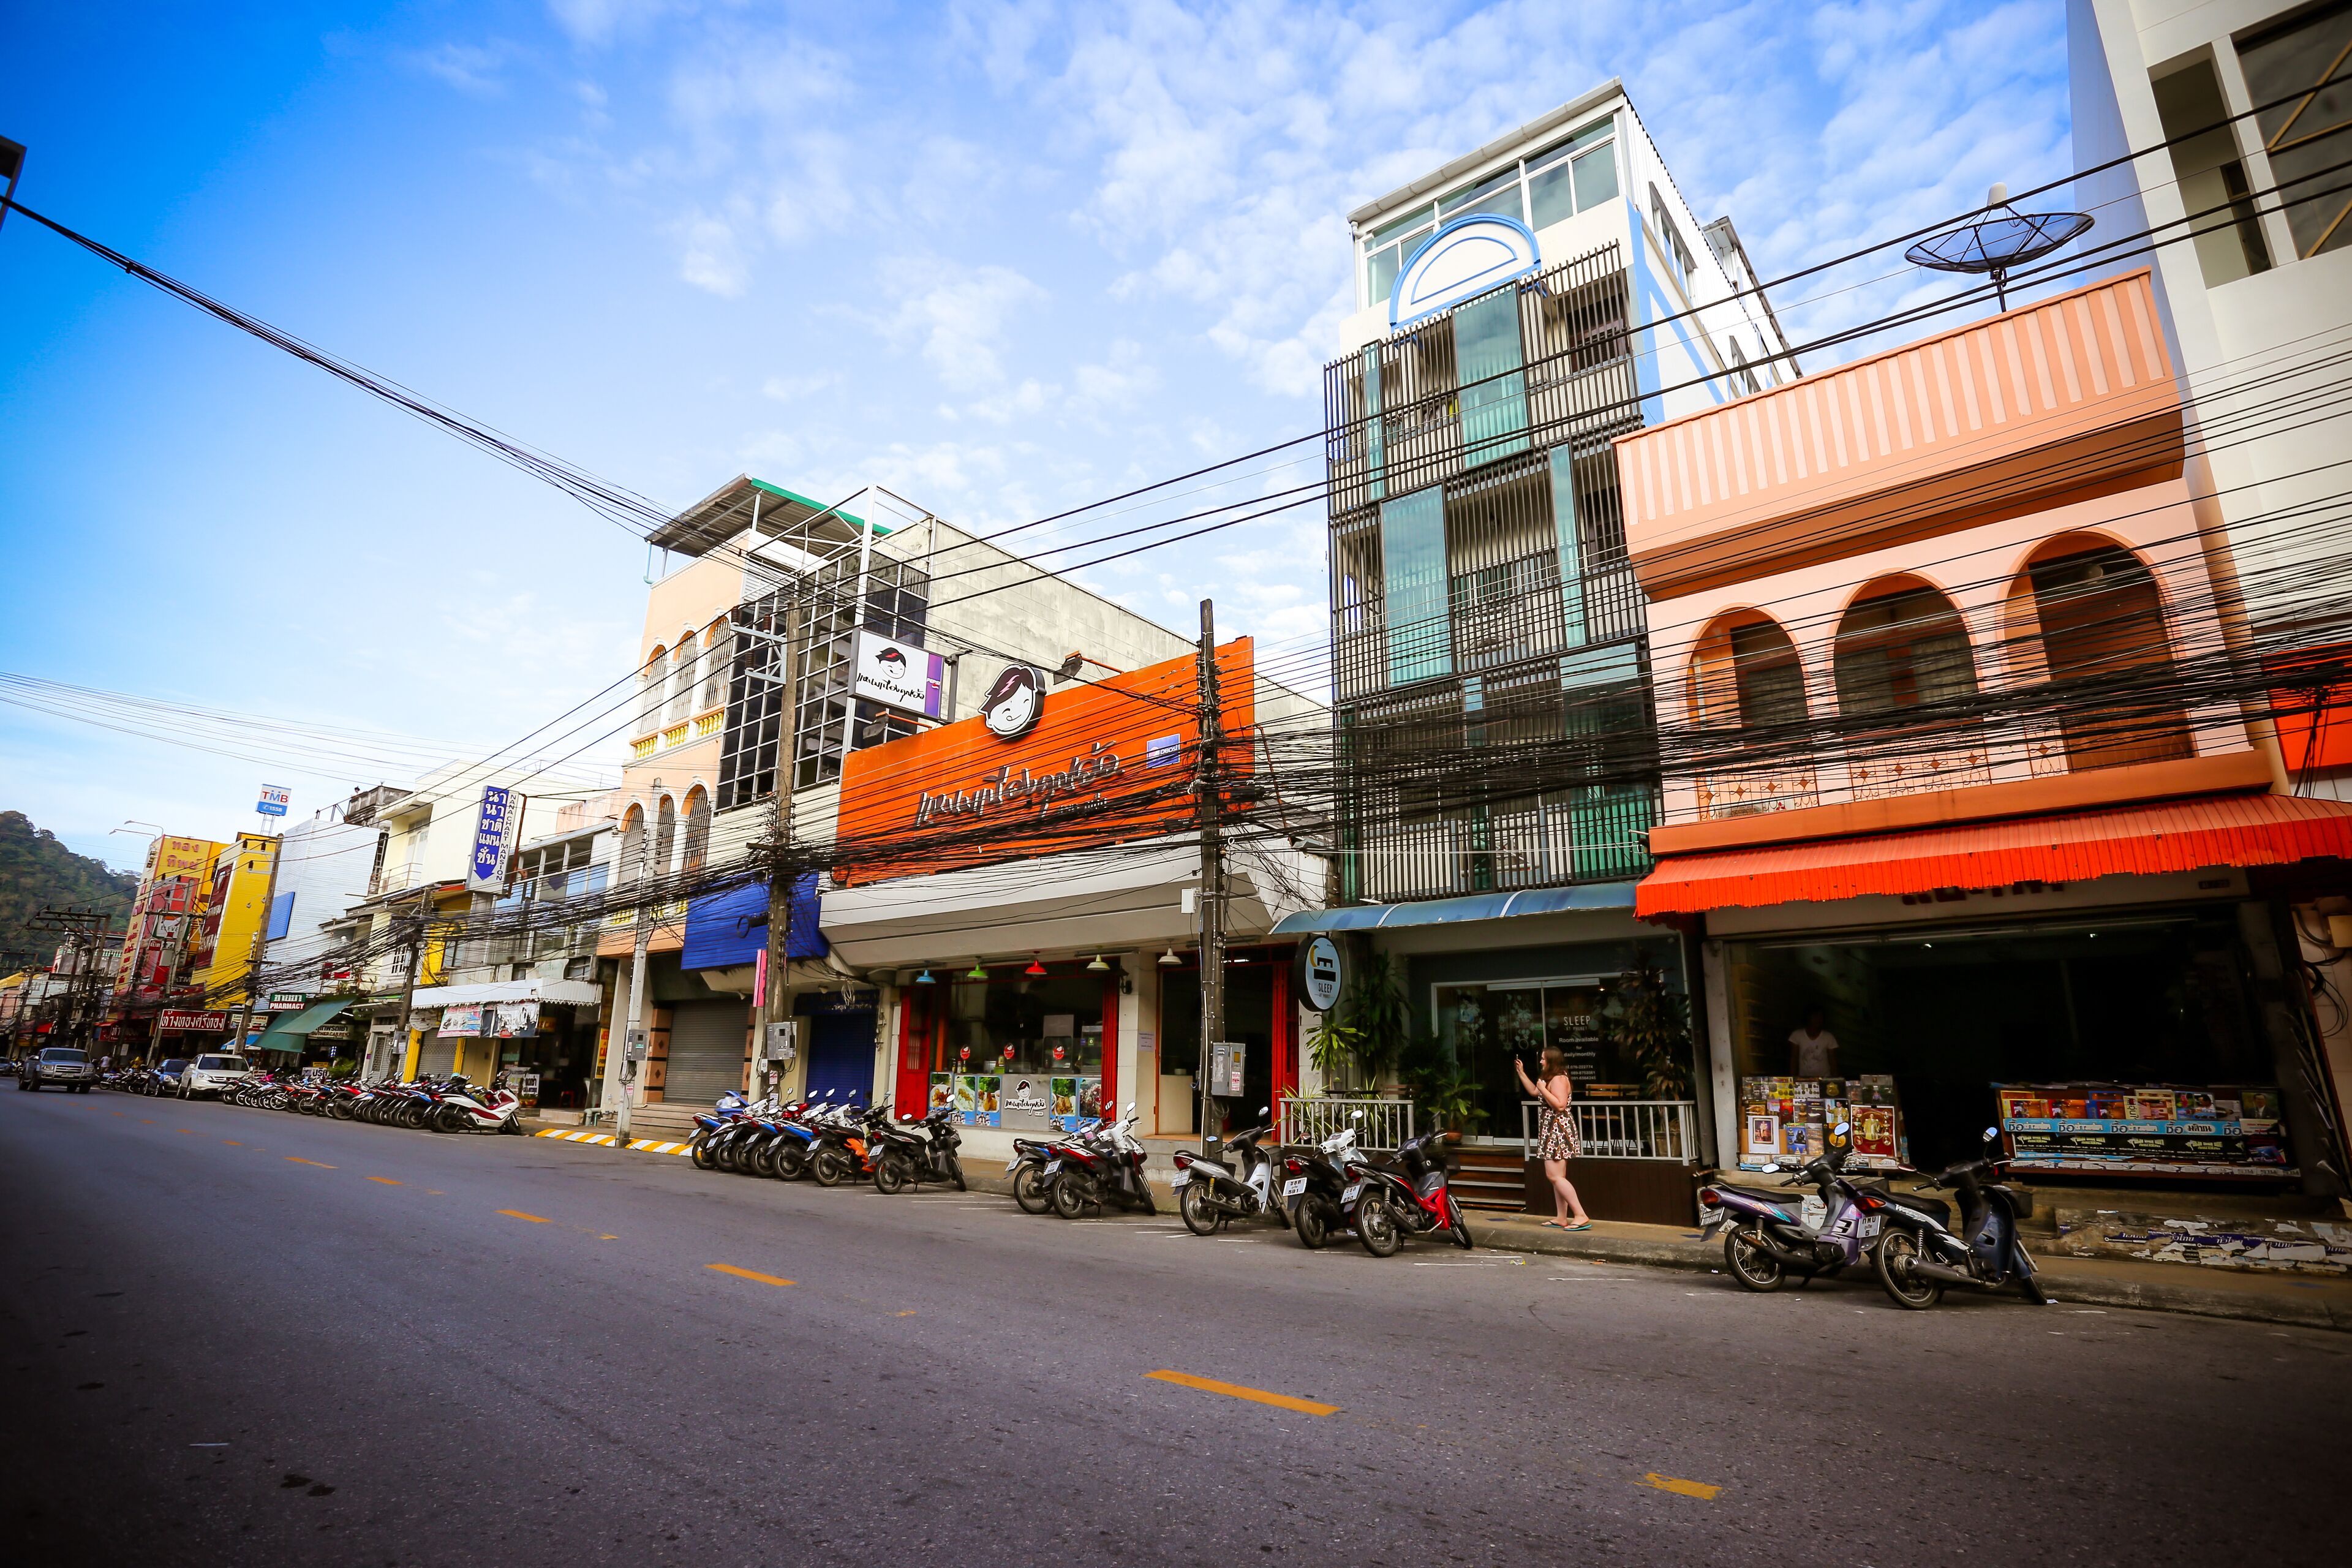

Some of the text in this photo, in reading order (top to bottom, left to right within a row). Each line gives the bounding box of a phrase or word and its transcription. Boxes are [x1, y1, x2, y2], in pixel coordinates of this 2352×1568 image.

[1160, 744, 1178, 755] pepsi
[262, 790, 288, 803] TMB
[485, 803, 505, 817] นา
[481, 818, 503, 833] ชาติ
[478, 832, 500, 846] แมน
[172, 840, 200, 853] ทอง
[496, 843, 509, 881] MANSION
[1318, 982, 1333, 993] SLEEP
[1564, 1016, 1591, 1026] SLEEP
